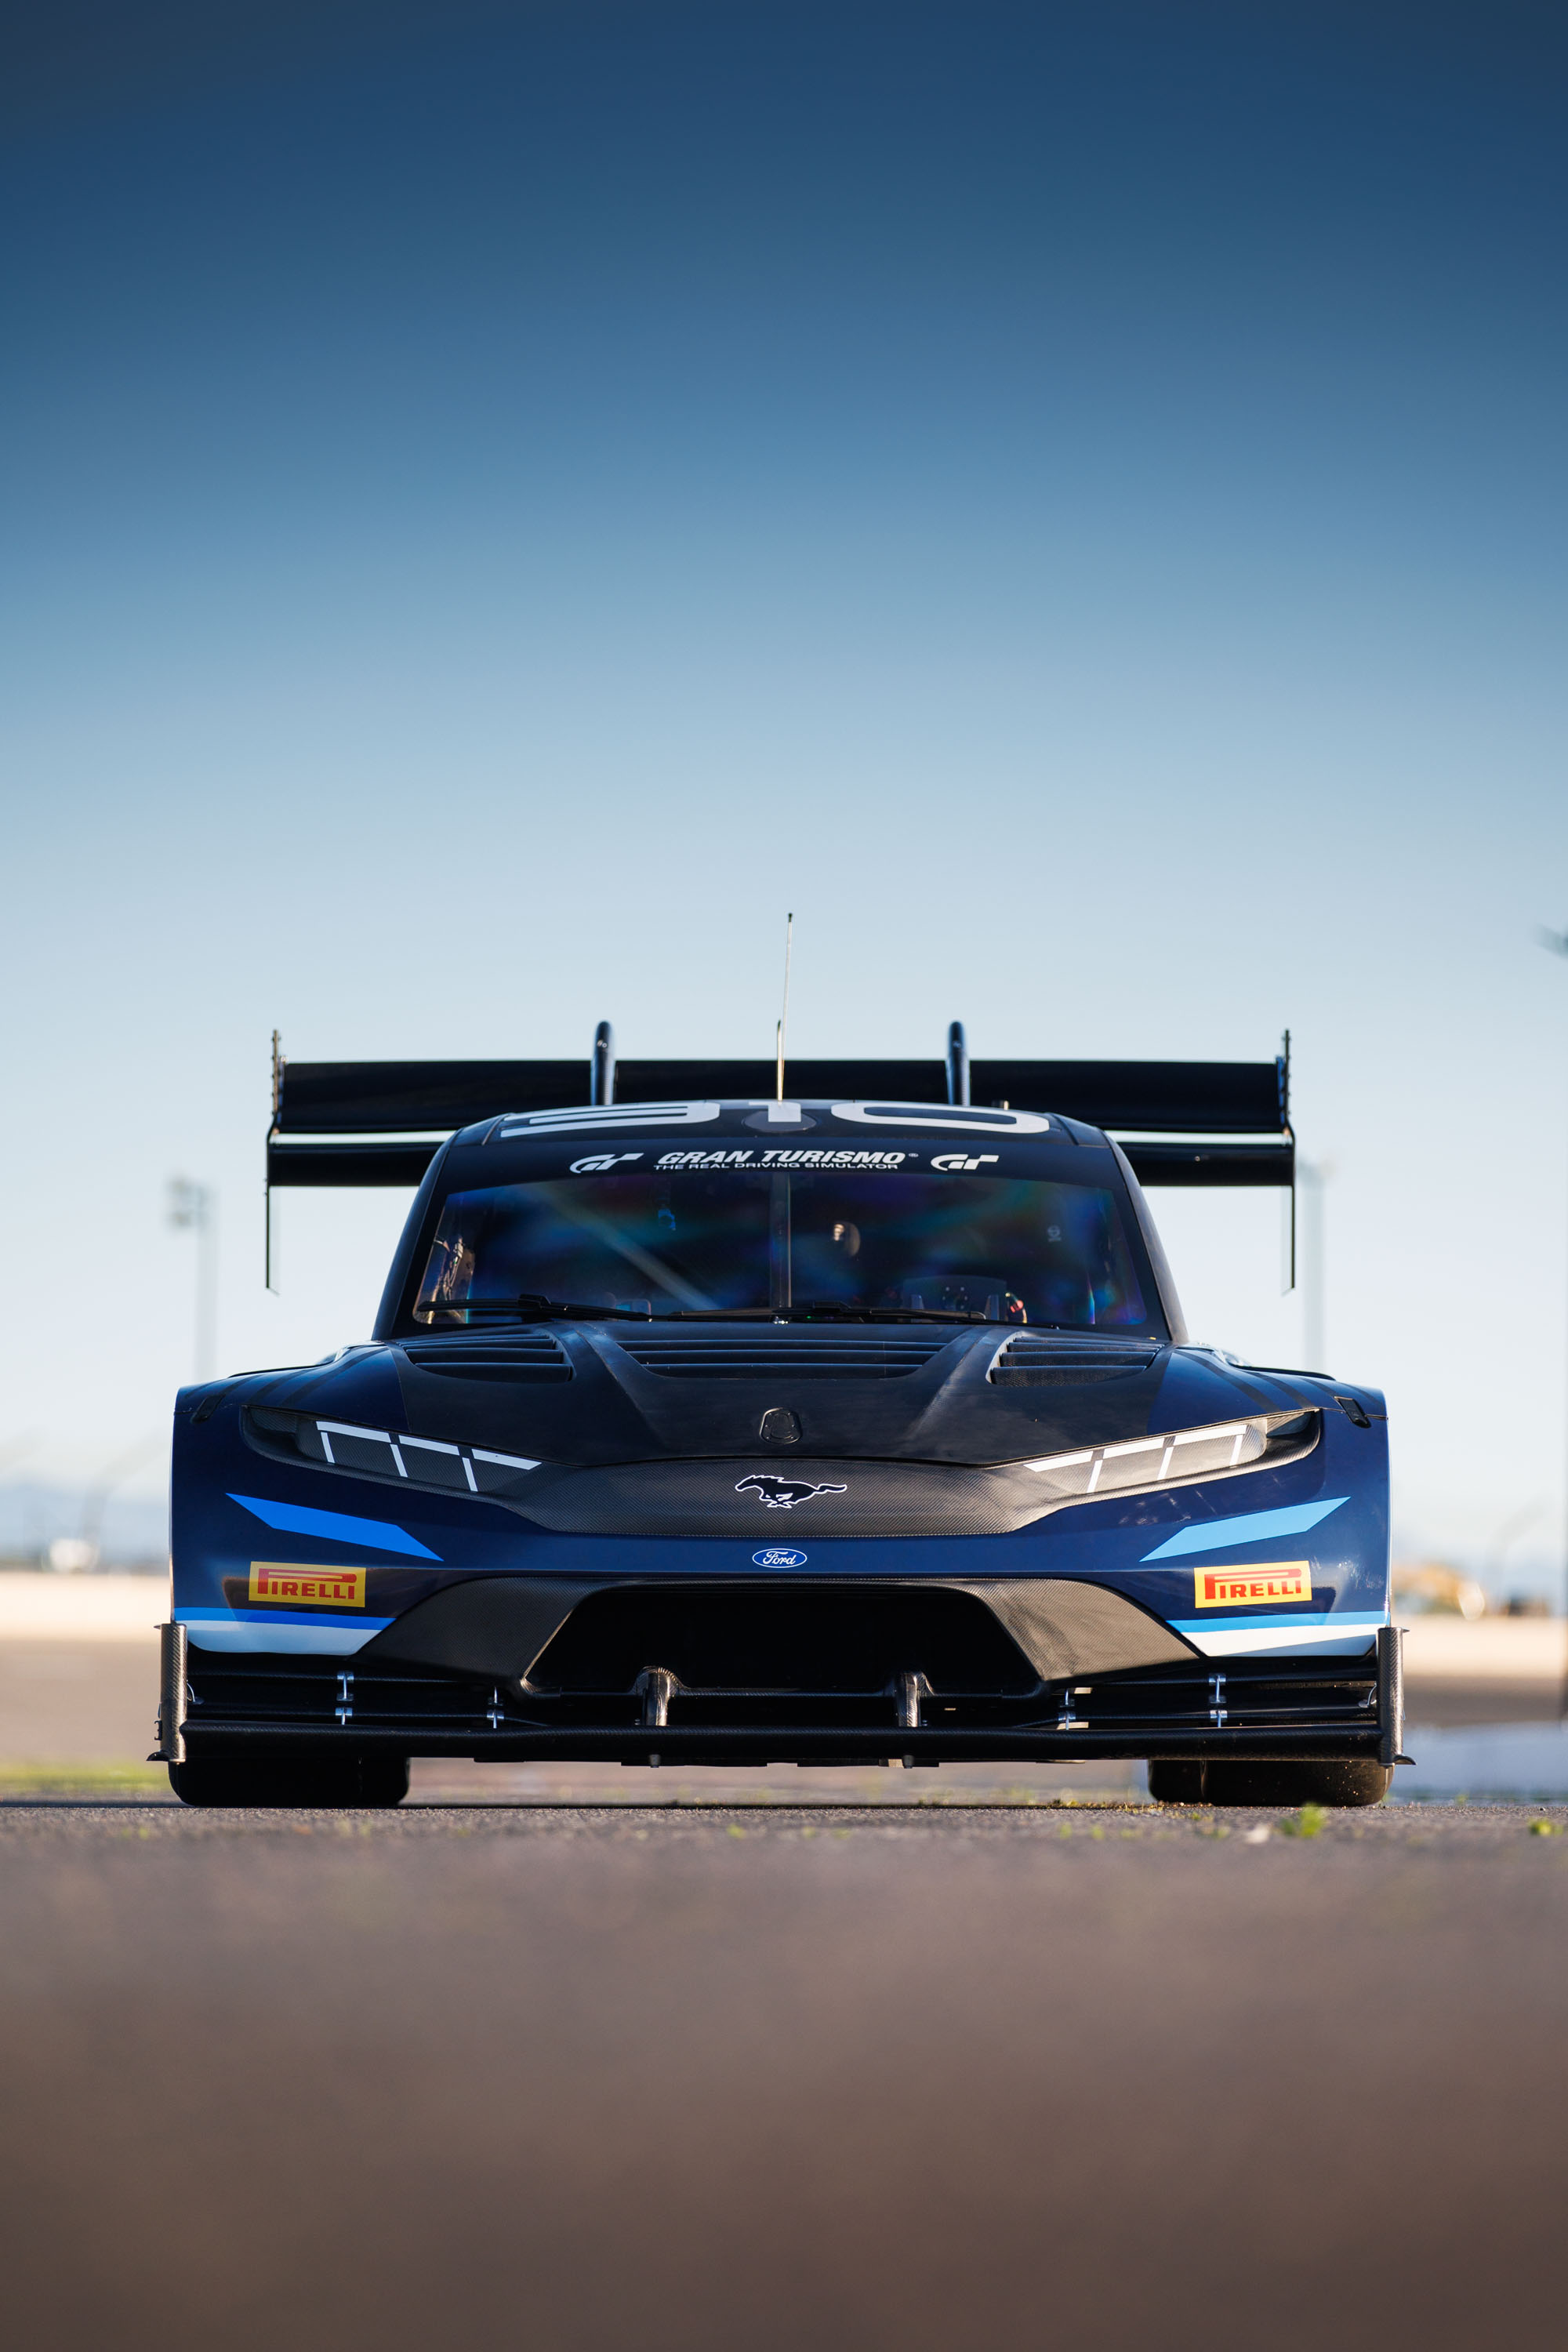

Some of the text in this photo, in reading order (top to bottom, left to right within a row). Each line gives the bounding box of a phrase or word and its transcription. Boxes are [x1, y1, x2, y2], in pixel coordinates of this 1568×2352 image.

[658, 1150, 754, 1165] GRAN
[762, 1551, 797, 1565] Ford
[257, 1567, 358, 1600] PIRELLI
[1204, 1568, 1302, 1600] PIRELLI
